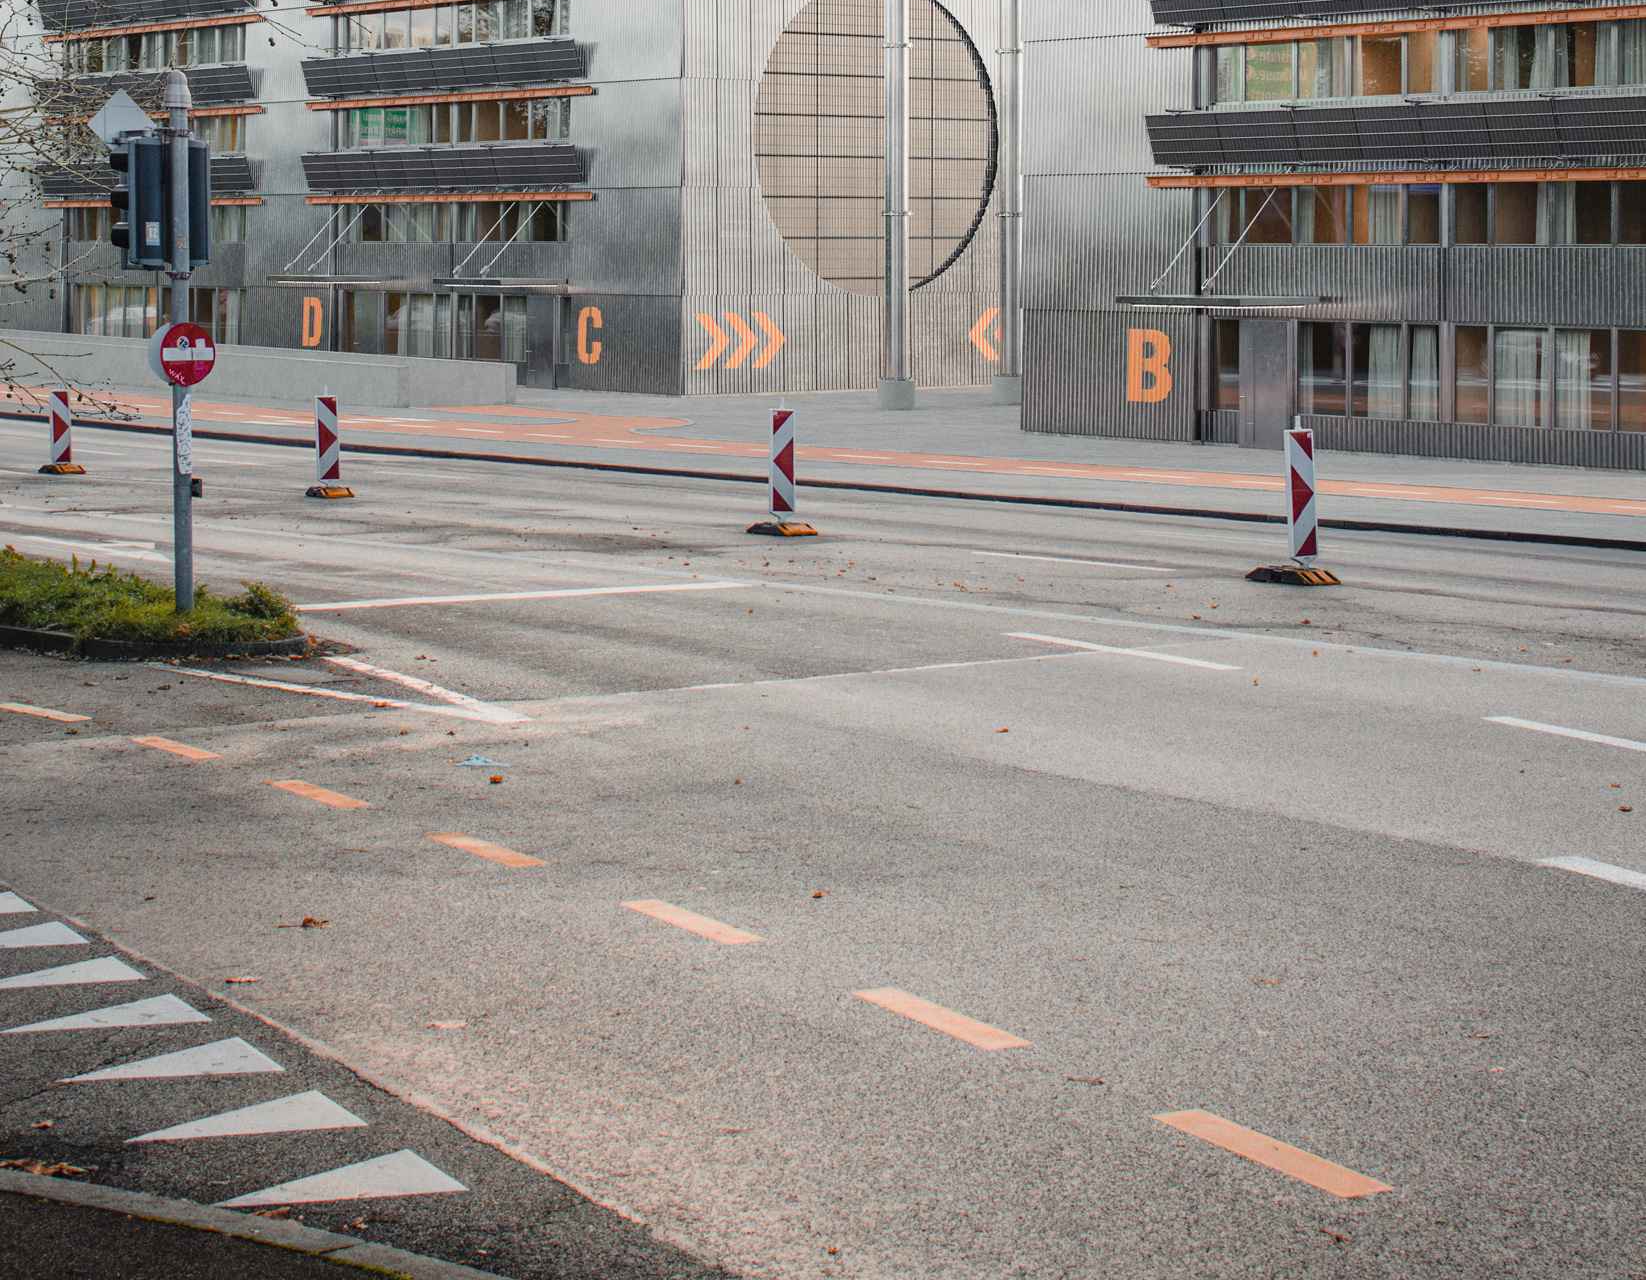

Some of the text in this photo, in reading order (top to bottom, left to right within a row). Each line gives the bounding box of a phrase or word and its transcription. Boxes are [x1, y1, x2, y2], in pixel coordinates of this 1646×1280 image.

[302, 297, 322, 347] D
[578, 307, 603, 364] C
[1127, 328, 1173, 403] B
